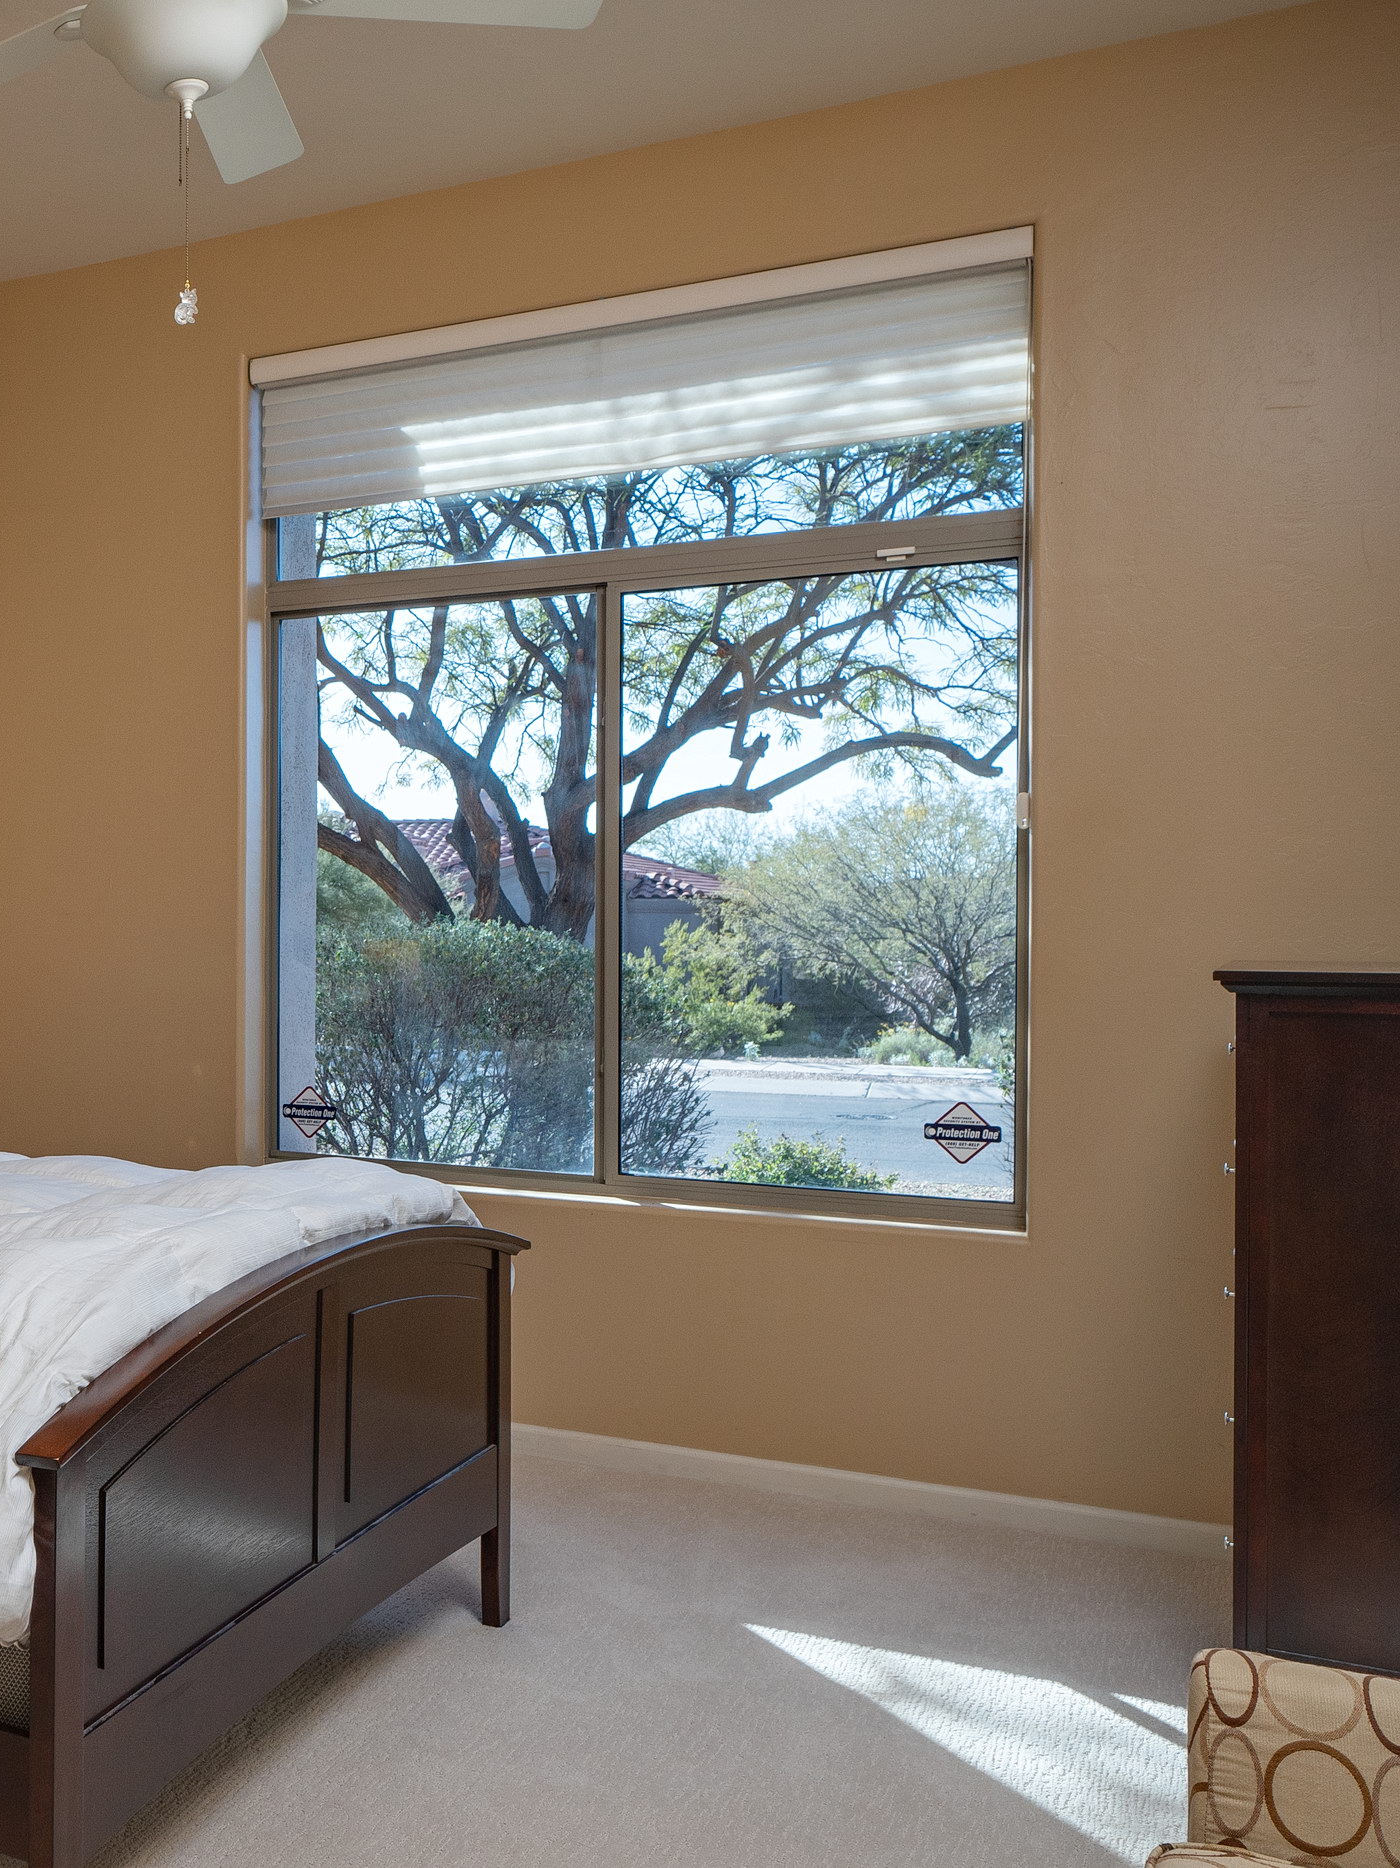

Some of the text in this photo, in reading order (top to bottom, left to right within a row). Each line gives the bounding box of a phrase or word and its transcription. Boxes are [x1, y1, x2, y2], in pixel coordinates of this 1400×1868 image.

[291, 1107, 335, 1118] Protection One
[936, 1127, 999, 1140] Protection One
